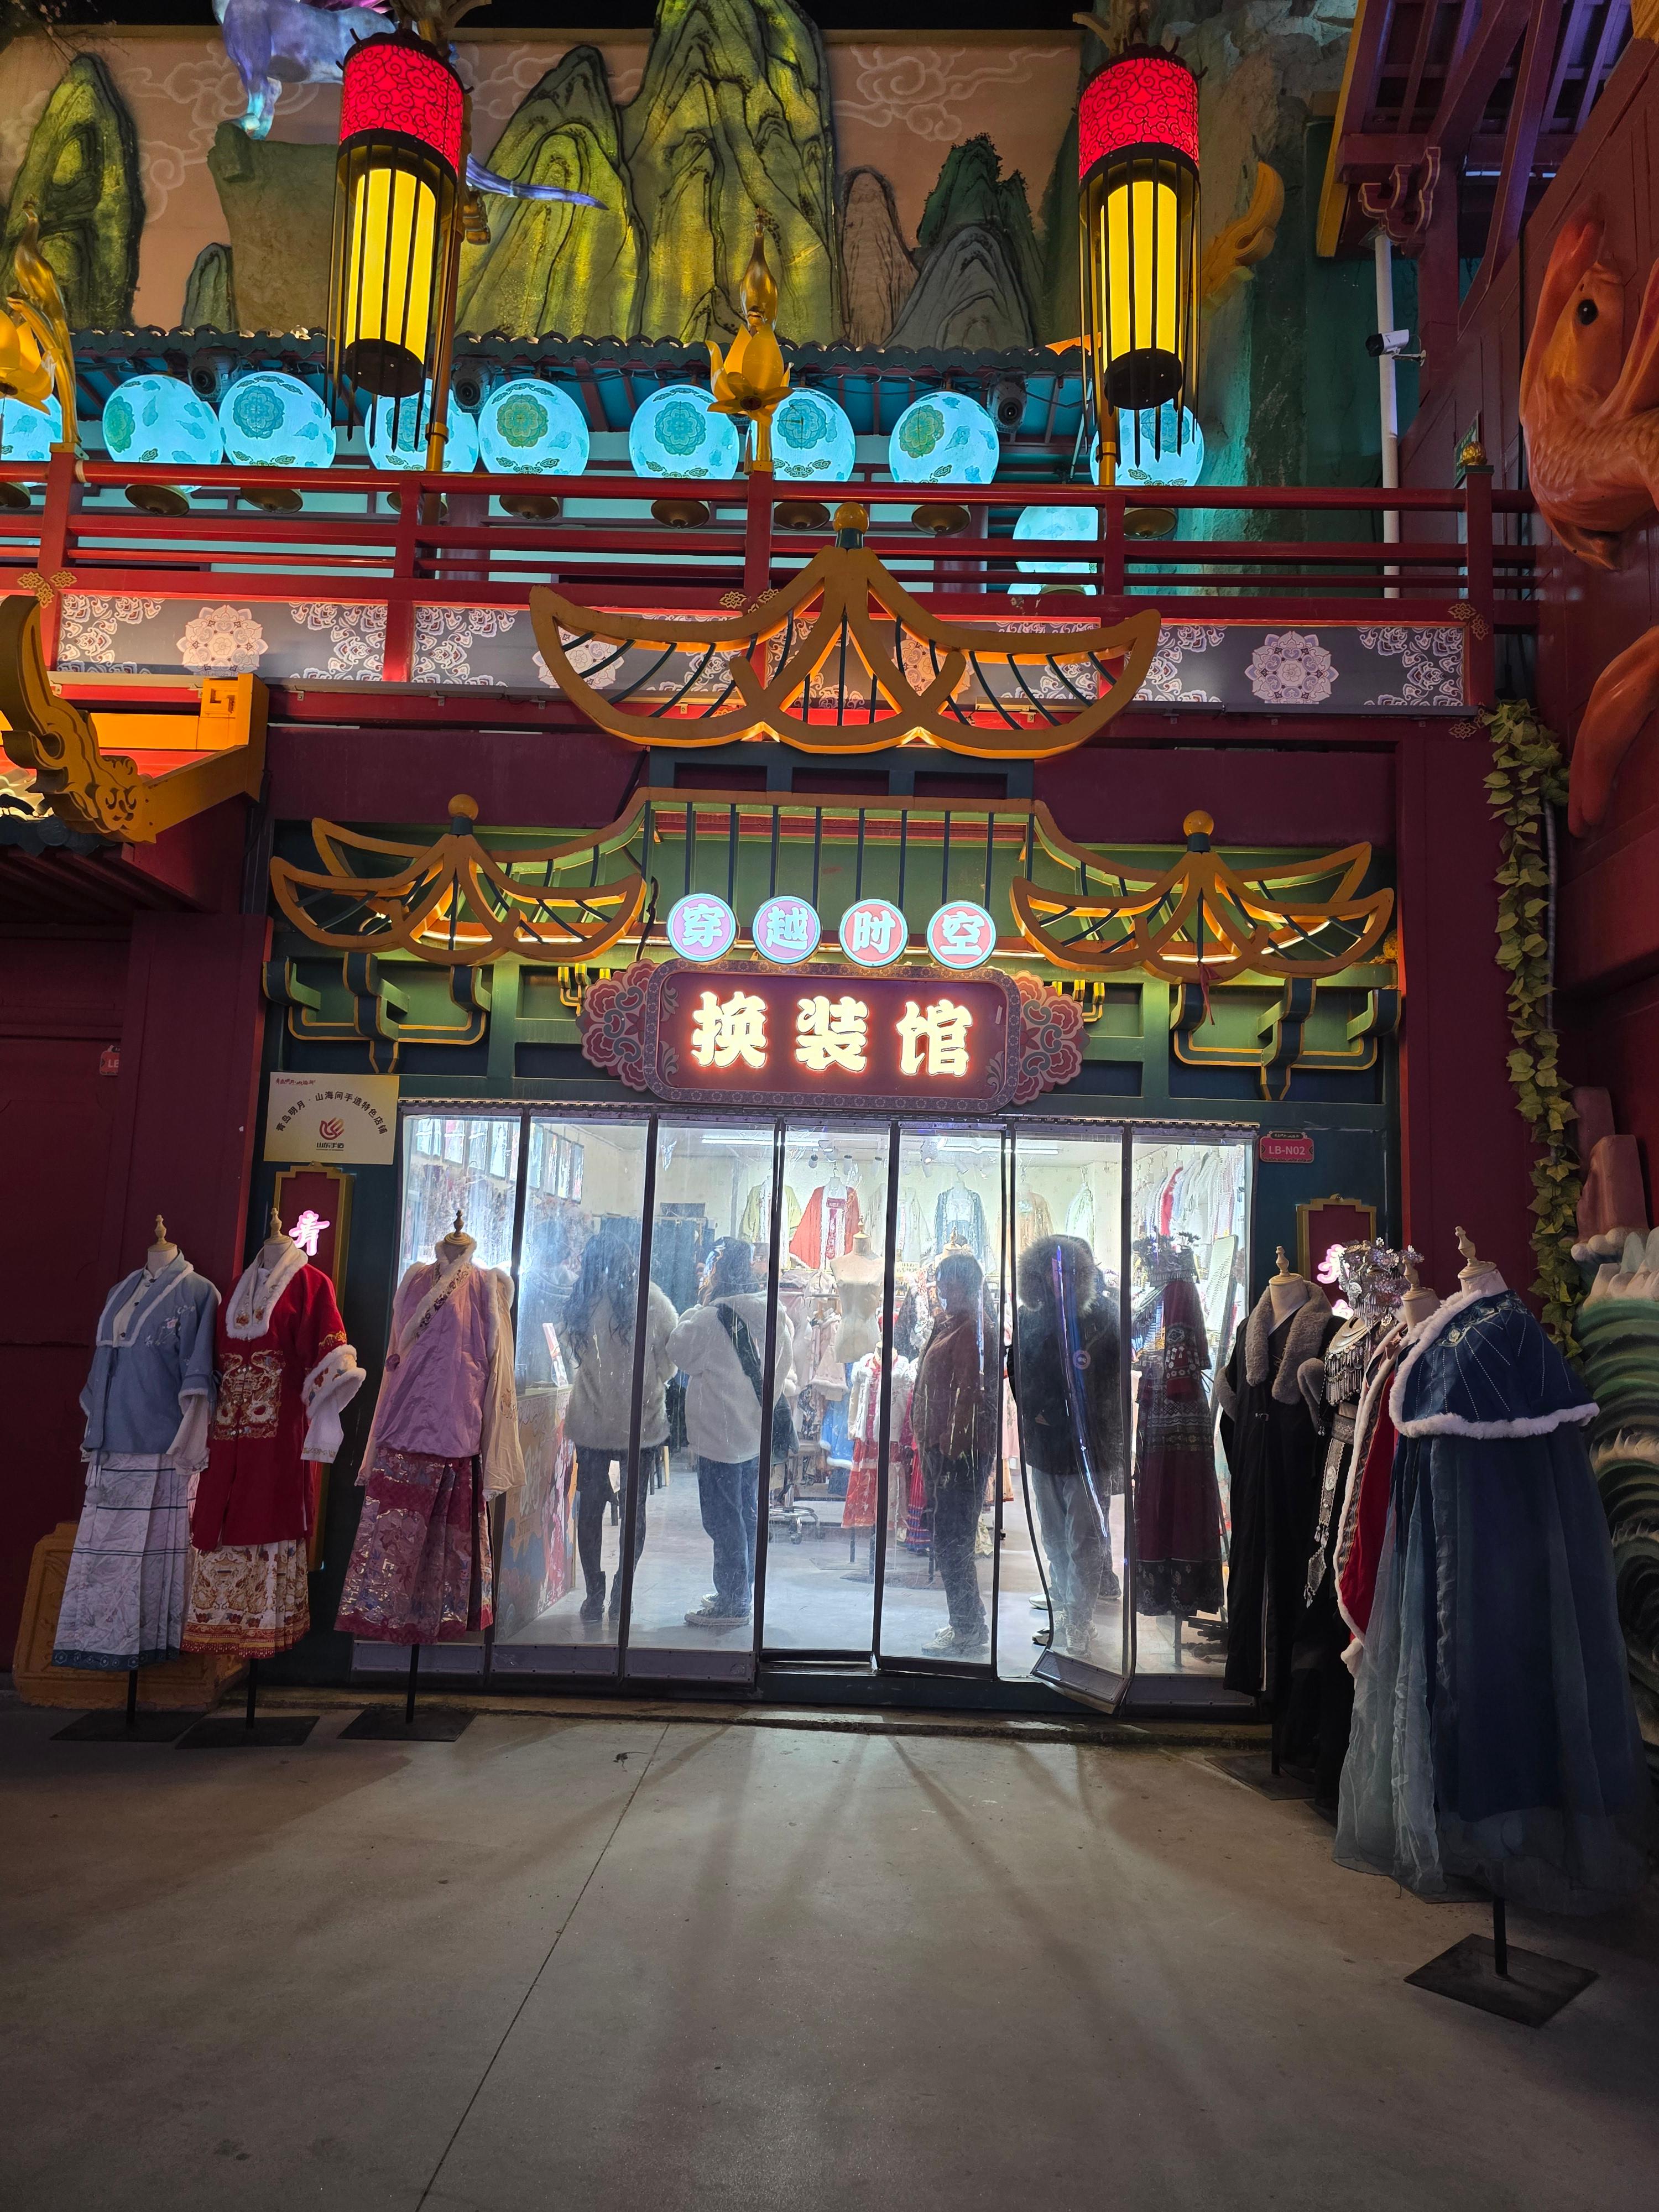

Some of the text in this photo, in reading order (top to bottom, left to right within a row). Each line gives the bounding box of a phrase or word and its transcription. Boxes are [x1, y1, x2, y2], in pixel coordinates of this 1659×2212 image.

[682, 905, 985, 957] 穿越时空
[691, 991, 973, 1077] 换装馆
[1269, 1146, 1306, 1155] LB-N02
